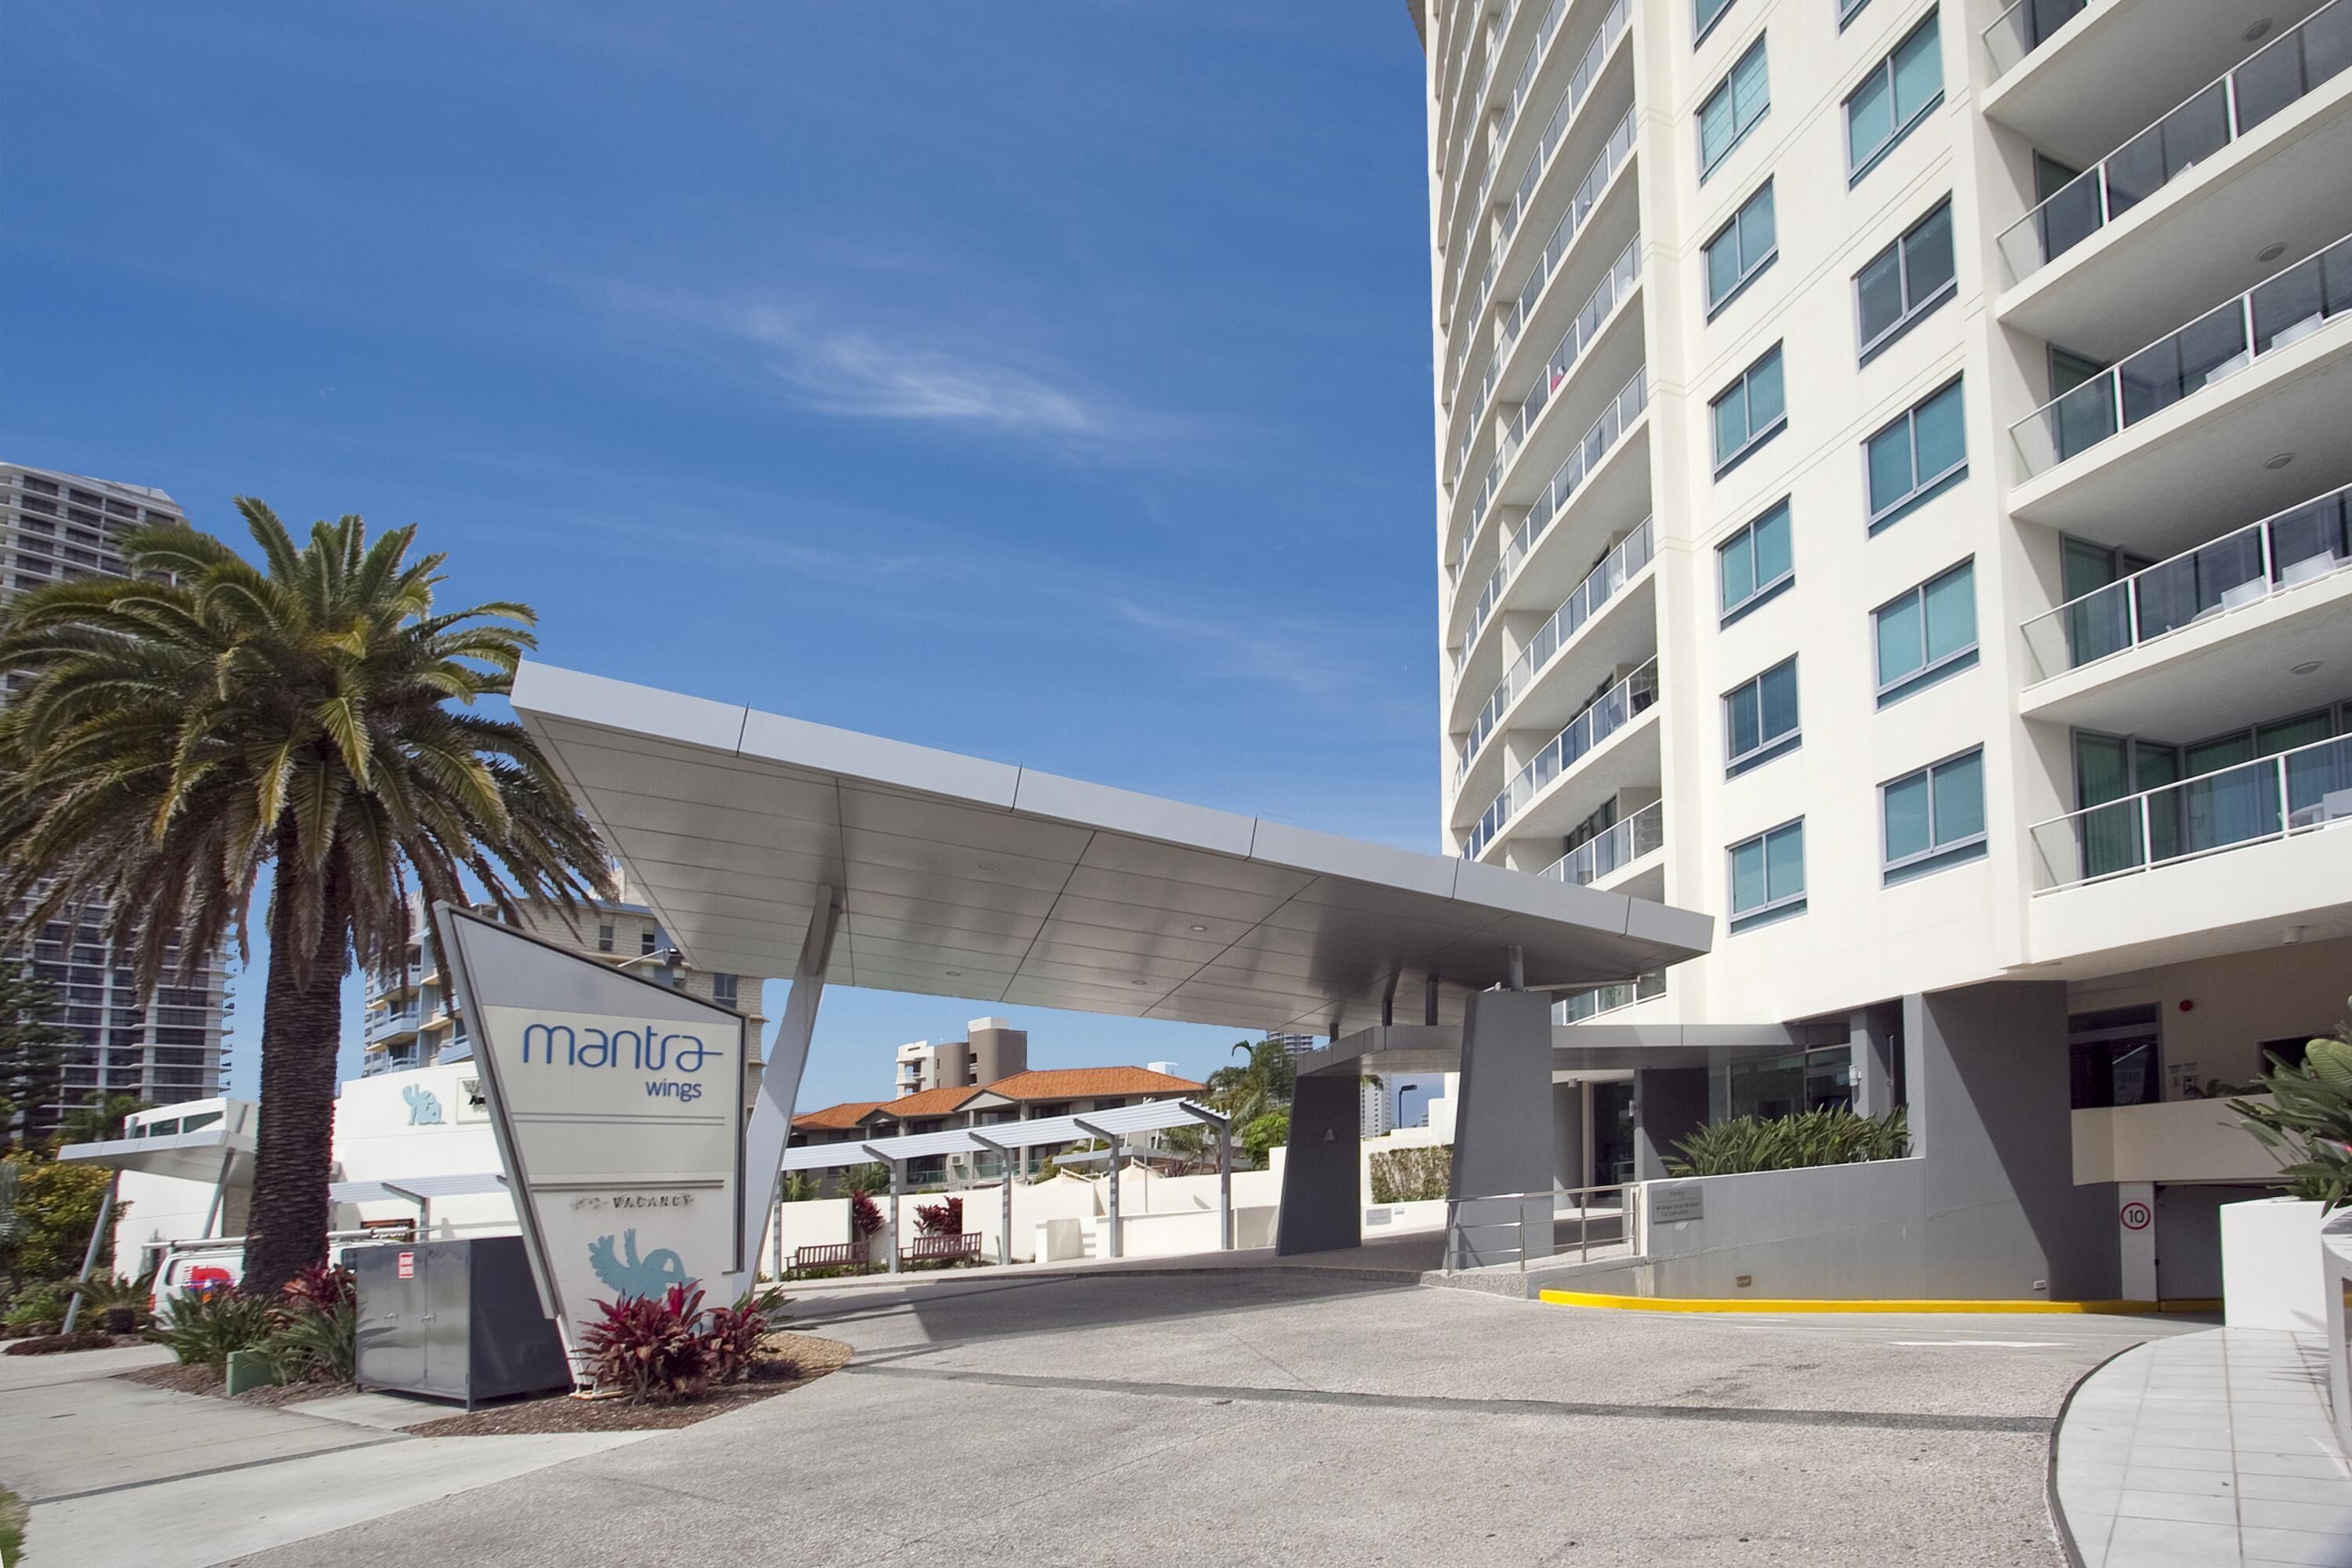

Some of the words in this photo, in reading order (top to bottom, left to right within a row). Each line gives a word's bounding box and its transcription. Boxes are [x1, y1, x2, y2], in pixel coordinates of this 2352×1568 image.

[522, 1023, 724, 1073] mantra
[645, 1078, 702, 1102] wings
[2129, 1210, 2145, 1224] 10
